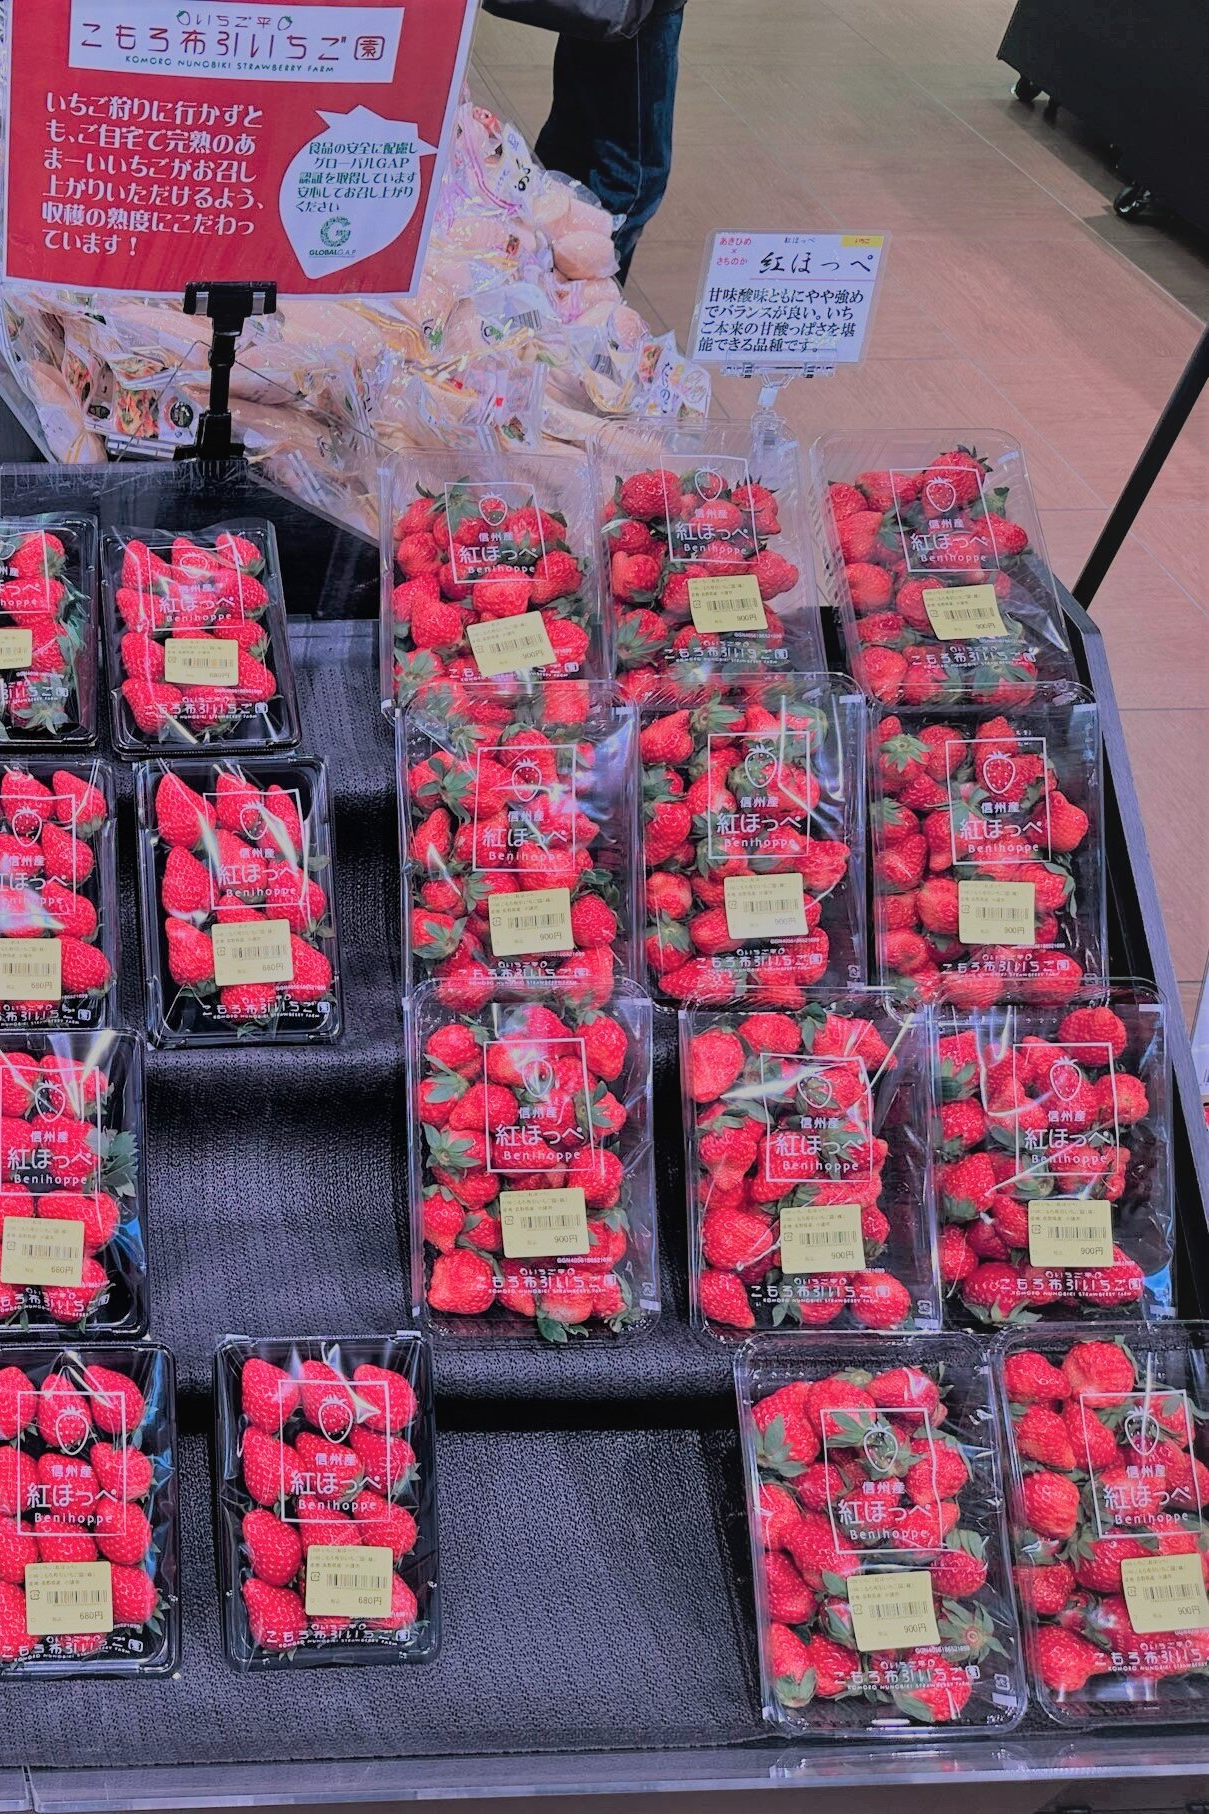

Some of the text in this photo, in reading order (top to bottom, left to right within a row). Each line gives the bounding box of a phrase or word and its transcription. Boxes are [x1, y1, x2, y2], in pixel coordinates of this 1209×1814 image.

[195, 15, 271, 28] いちご平
[81, 23, 386, 61] こもろ布引いちご園
[125, 56, 334, 73] KOMORO NUNOBIKI STRAWBERRY FARM
[46, 93, 263, 128] いちご狩りに行かずと
[45, 120, 256, 156] も、ご自宅で完熟のあ
[309, 142, 418, 154] 食品の安全に配慮し
[44, 147, 257, 182] まーいいちごがお召し
[314, 158, 409, 168] グローバルGAP
[299, 172, 416, 184] 認証を取得しています
[42, 175, 264, 210] 上がりいただけるよう、
[298, 187, 414, 198] 安心してお召し上がり
[296, 201, 339, 212] ください
[42, 202, 254, 236] 収穫の熟度にこだわっ
[42, 230, 137, 256] ています！
[719, 238, 751, 246] あきひめ
[717, 257, 747, 266] さちのか
[759, 252, 873, 273] 紅ほっぺ
[708, 287, 864, 304] 甘味酸味ともにやや強め
[706, 306, 853, 321] でバランスが良い。いち
[700, 321, 856, 337] ご本来の甘酸っぱさを堪
[698, 337, 818, 353] 能できる品種です。
[675, 522, 749, 541] 紅ほっぺ
[911, 532, 988, 551] 紅ほっぺ
[459, 545, 538, 564] 紅ほっぺ
[684, 543, 747, 555] Benihoppe
[920, 554, 987, 563] Benihoppe
[467, 563, 536, 574] Benihoppe
[159, 596, 235, 613] 紅ほっぺ
[166, 612, 232, 622] Benihoppe
[717, 813, 802, 832] 紅ほっぺ
[959, 818, 1042, 840] 紅ほっぺ
[482, 827, 567, 847] 紅ほっぺ
[724, 837, 795, 849] Benihoppe
[968, 842, 1039, 854] Benihoppe
[489, 851, 563, 862] Benihoppe
[218, 864, 298, 885] 紅ほっぺ
[226, 886, 297, 898] Benihoppe
[539, 931, 563, 941] 900円
[1003, 926, 1025, 935] 900円
[518, 1106, 557, 1119] 信州産
[1048, 1110, 1086, 1123] 信州産
[800, 1116, 839, 1129] 信州産
[30, 1131, 68, 1143] 信州産
[495, 1125, 584, 1146] 紅ほっぺ
[1024, 1129, 1111, 1151] 紅ほっぺ
[775, 1135, 864, 1156] 紅ほっぺ
[7, 1149, 93, 1171] 紅ほっぺ
[503, 1150, 581, 1163] Benihoppe
[1032, 1153, 1108, 1165] Benihoppe
[782, 1160, 860, 1173] Benihoppe
[14, 1174, 87, 1187] Benihoppe
[553, 1234, 578, 1244] 900円
[831, 1250, 854, 1260] 900円
[1079, 1246, 1103, 1256] 900円
[315, 1453, 356, 1466] 信州産
[50, 1464, 92, 1479] 信州産
[1126, 1465, 1166, 1478] 信州産
[290, 1470, 382, 1494] 紅ほっぺ
[862, 1481, 905, 1494] 信州産
[26, 1484, 118, 1508] 紅ほっぺ
[1103, 1485, 1192, 1510] 紅ほっぺ
[299, 1500, 376, 1511] Benihoppe
[838, 1500, 932, 1524] 紅ほっぺ
[34, 1512, 113, 1524] Benihoppe
[1115, 1511, 1189, 1522] Benihoppe
[850, 1528, 928, 1540] Benihoppe
[359, 1597, 382, 1605] 680円
[79, 1611, 104, 1621] 680円
[904, 1623, 927, 1633] 900円
